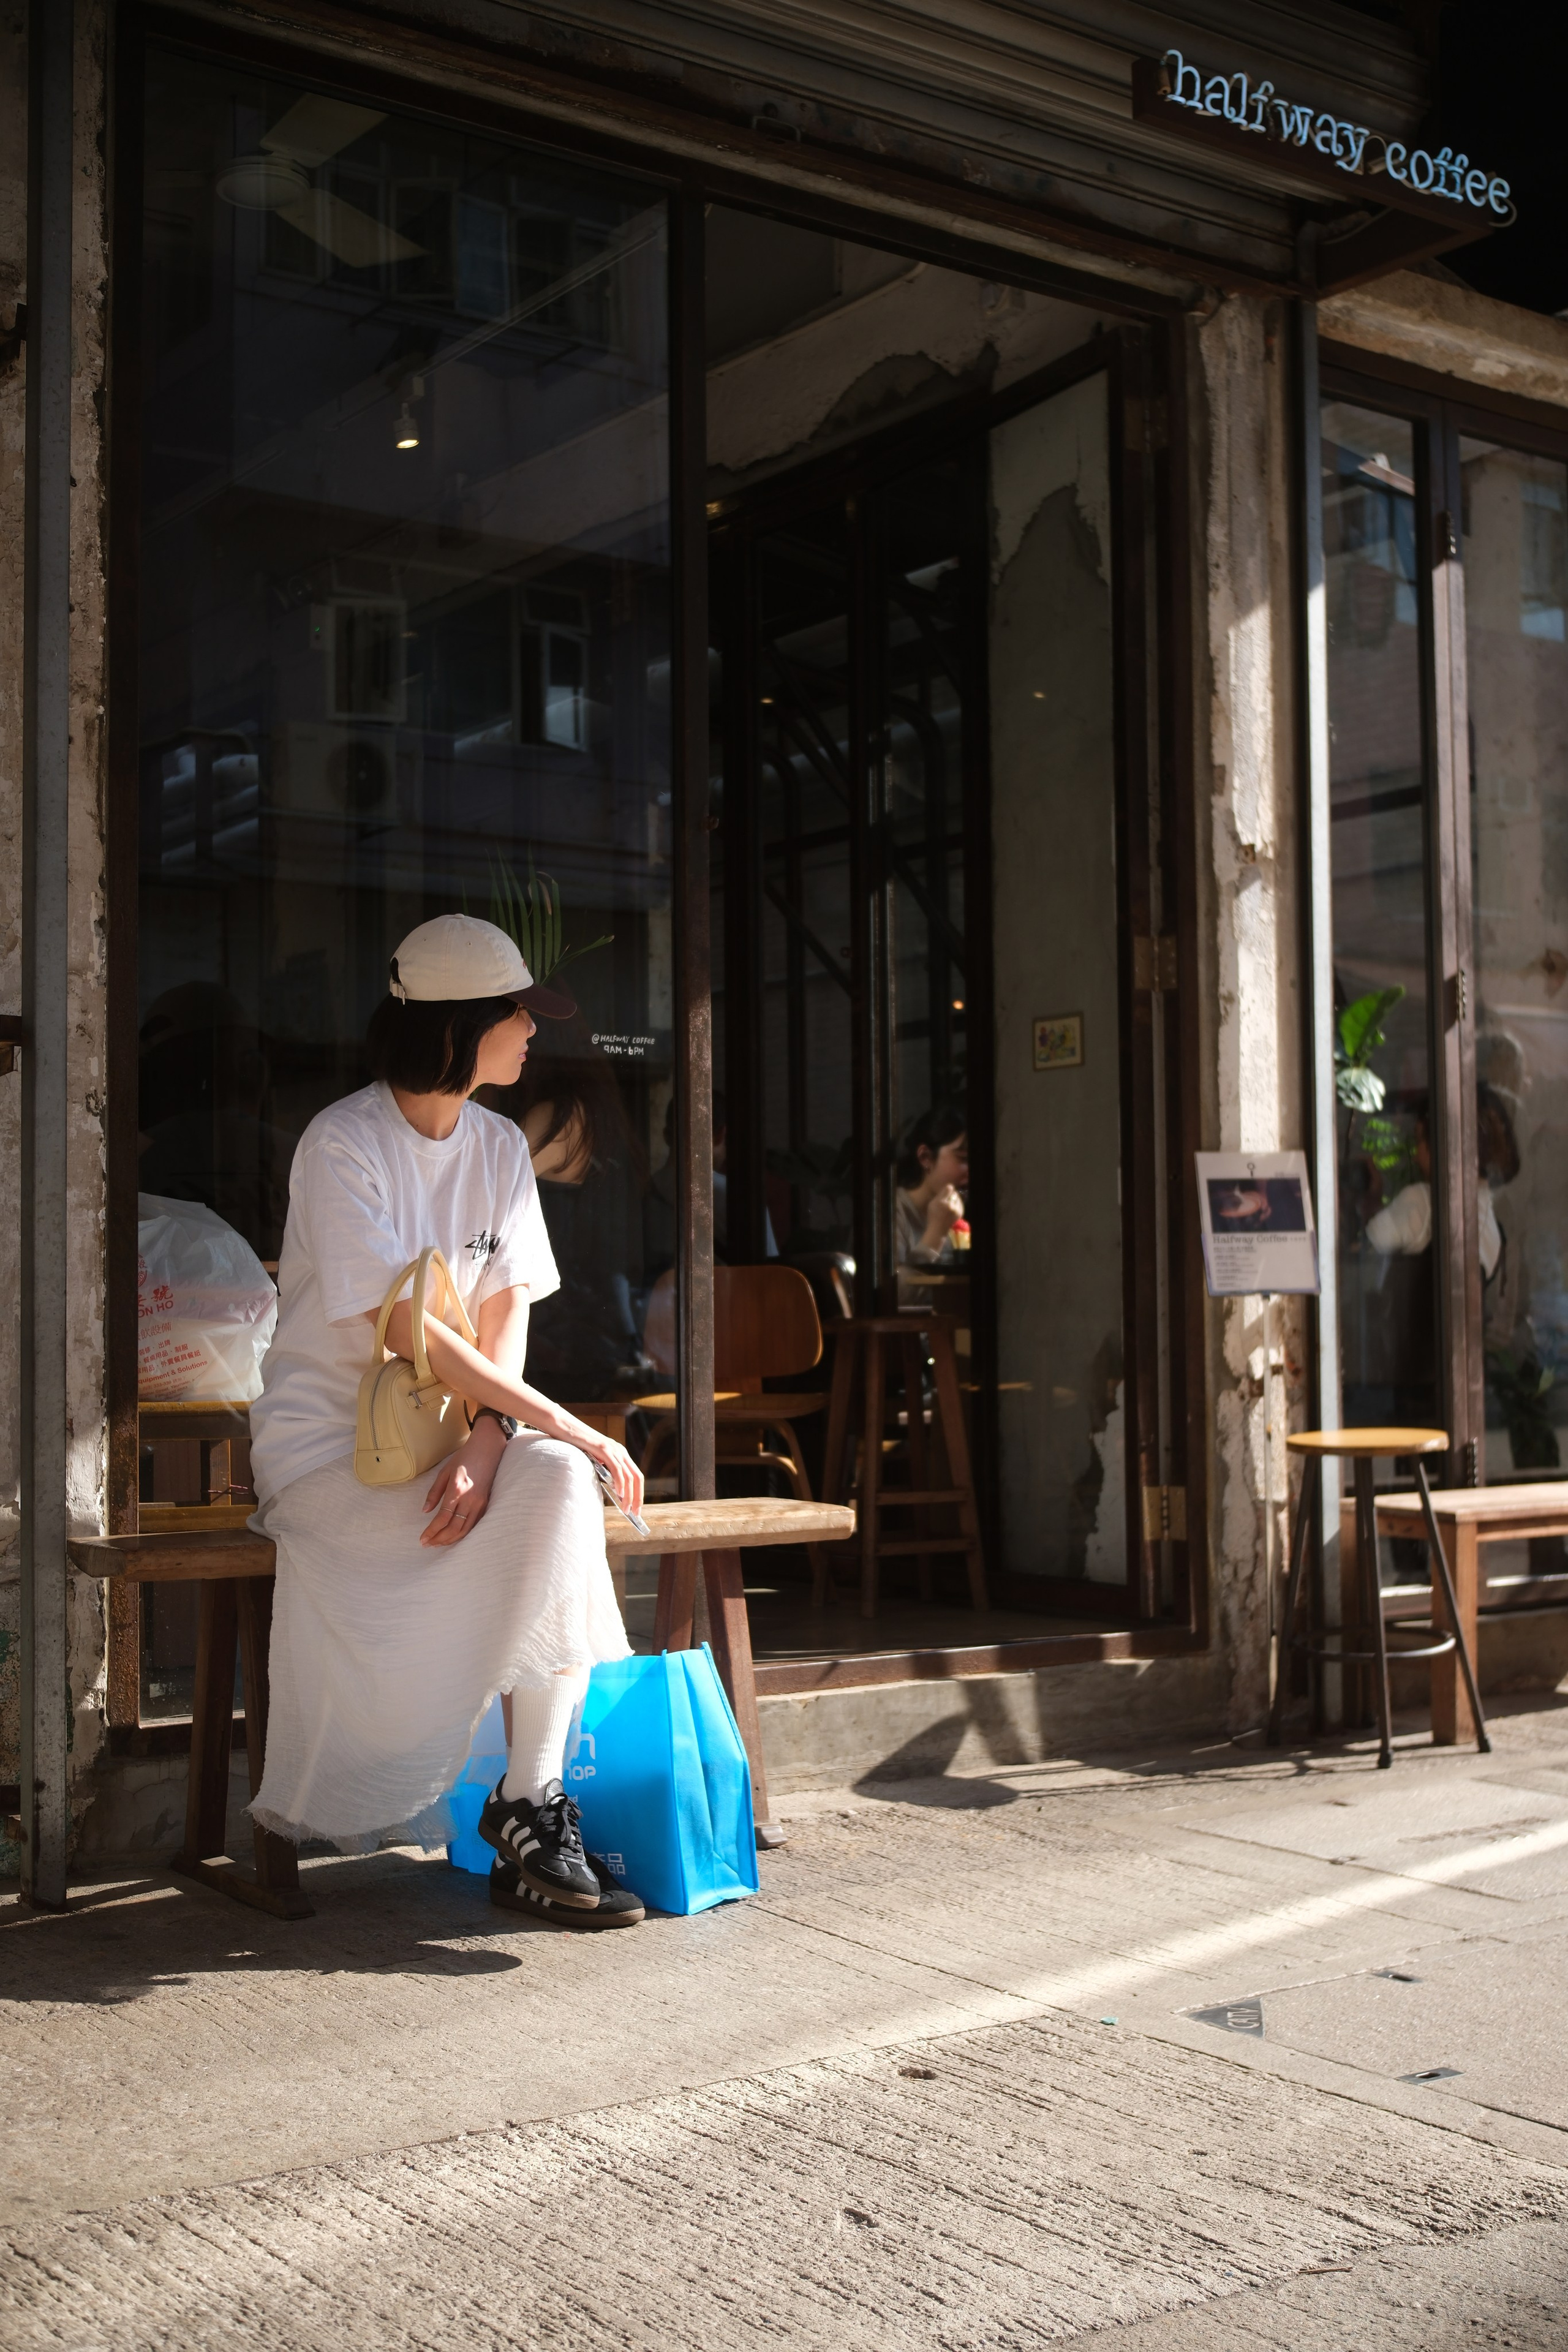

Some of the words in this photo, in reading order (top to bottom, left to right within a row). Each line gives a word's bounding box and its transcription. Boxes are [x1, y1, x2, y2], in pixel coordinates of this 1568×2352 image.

[1167, 49, 1370, 172] halfway
[1385, 141, 1510, 214] coffee
[1213, 1235, 1254, 1244] Halfway
[156, 1300, 174, 1312] HO
[138, 1371, 170, 1384] quipment
[177, 1360, 208, 1373] Solutions
[1227, 2006, 1260, 2029] CATV
